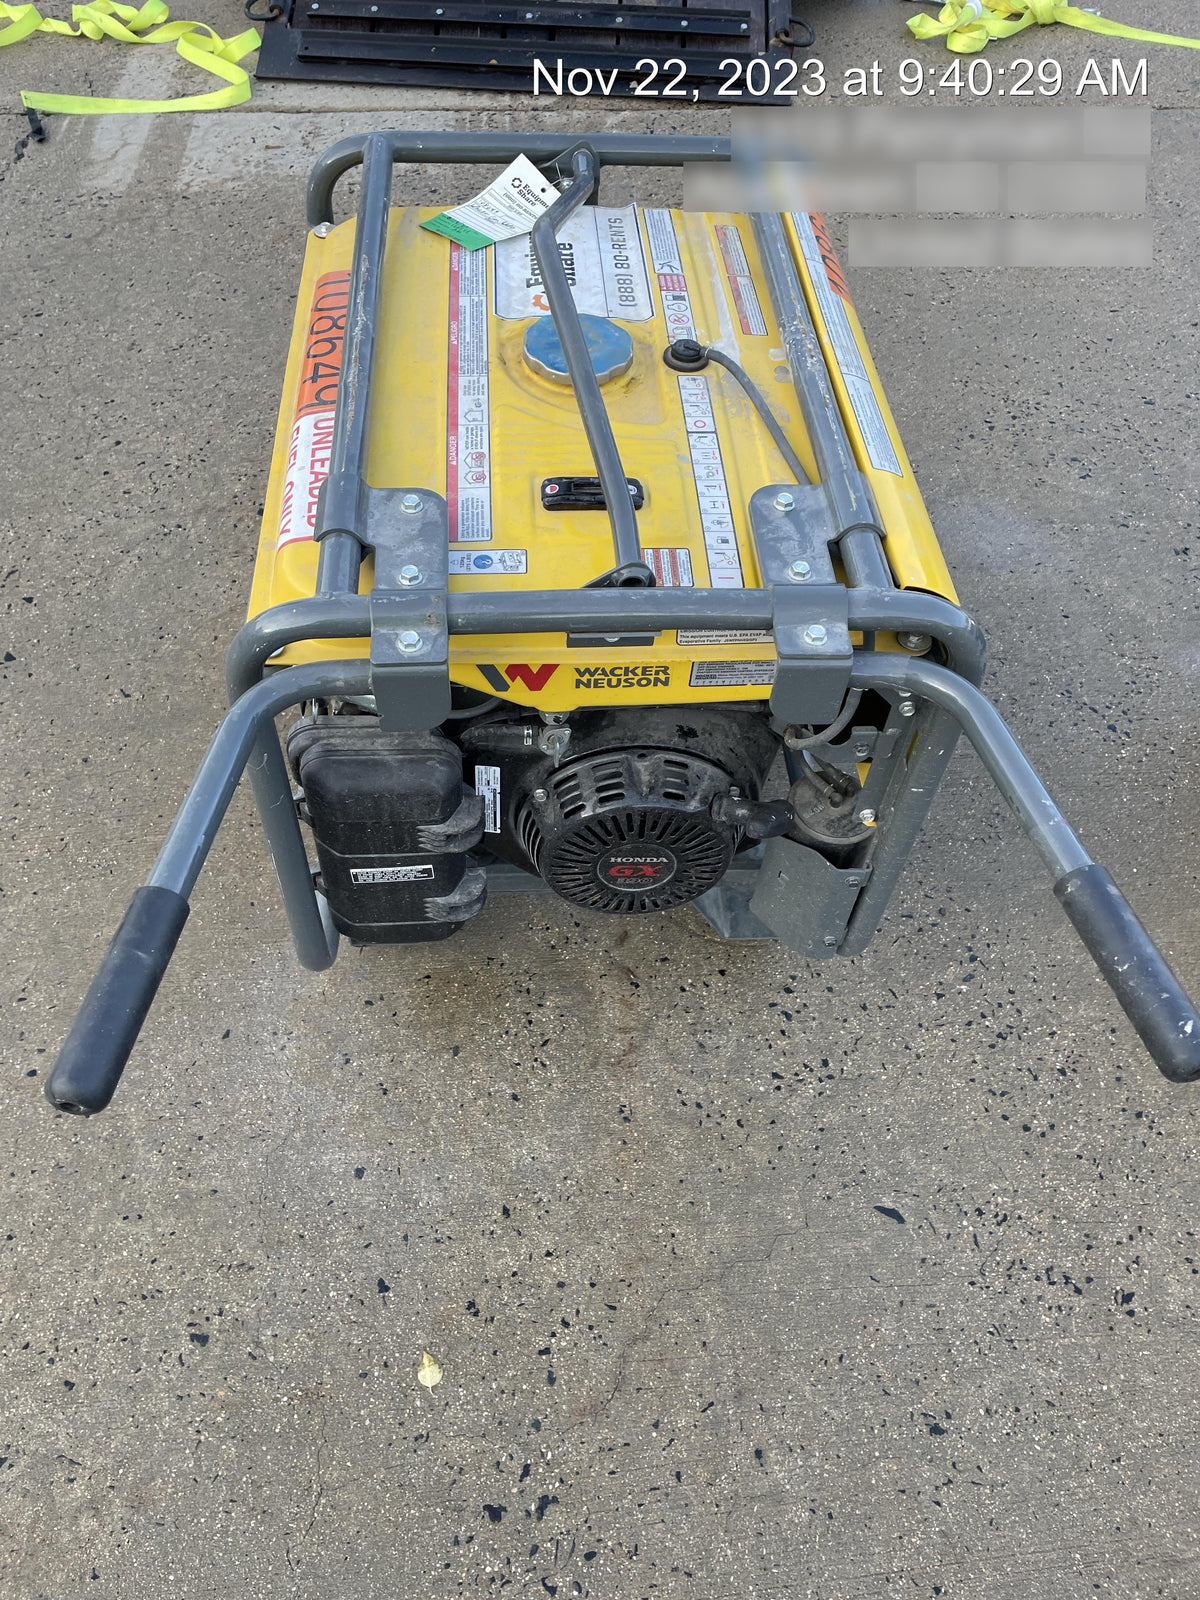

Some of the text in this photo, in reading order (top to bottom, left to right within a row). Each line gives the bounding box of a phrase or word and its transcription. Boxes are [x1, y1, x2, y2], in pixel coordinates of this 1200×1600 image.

[607, 217, 638, 307] (888) 80-RENTS
[450, 320, 458, 341] PELIGRO
[449, 435, 457, 461] DANGER
[574, 665, 670, 679] WACKER
[574, 677, 670, 690] NEUSON
[608, 864, 664, 877] GX
